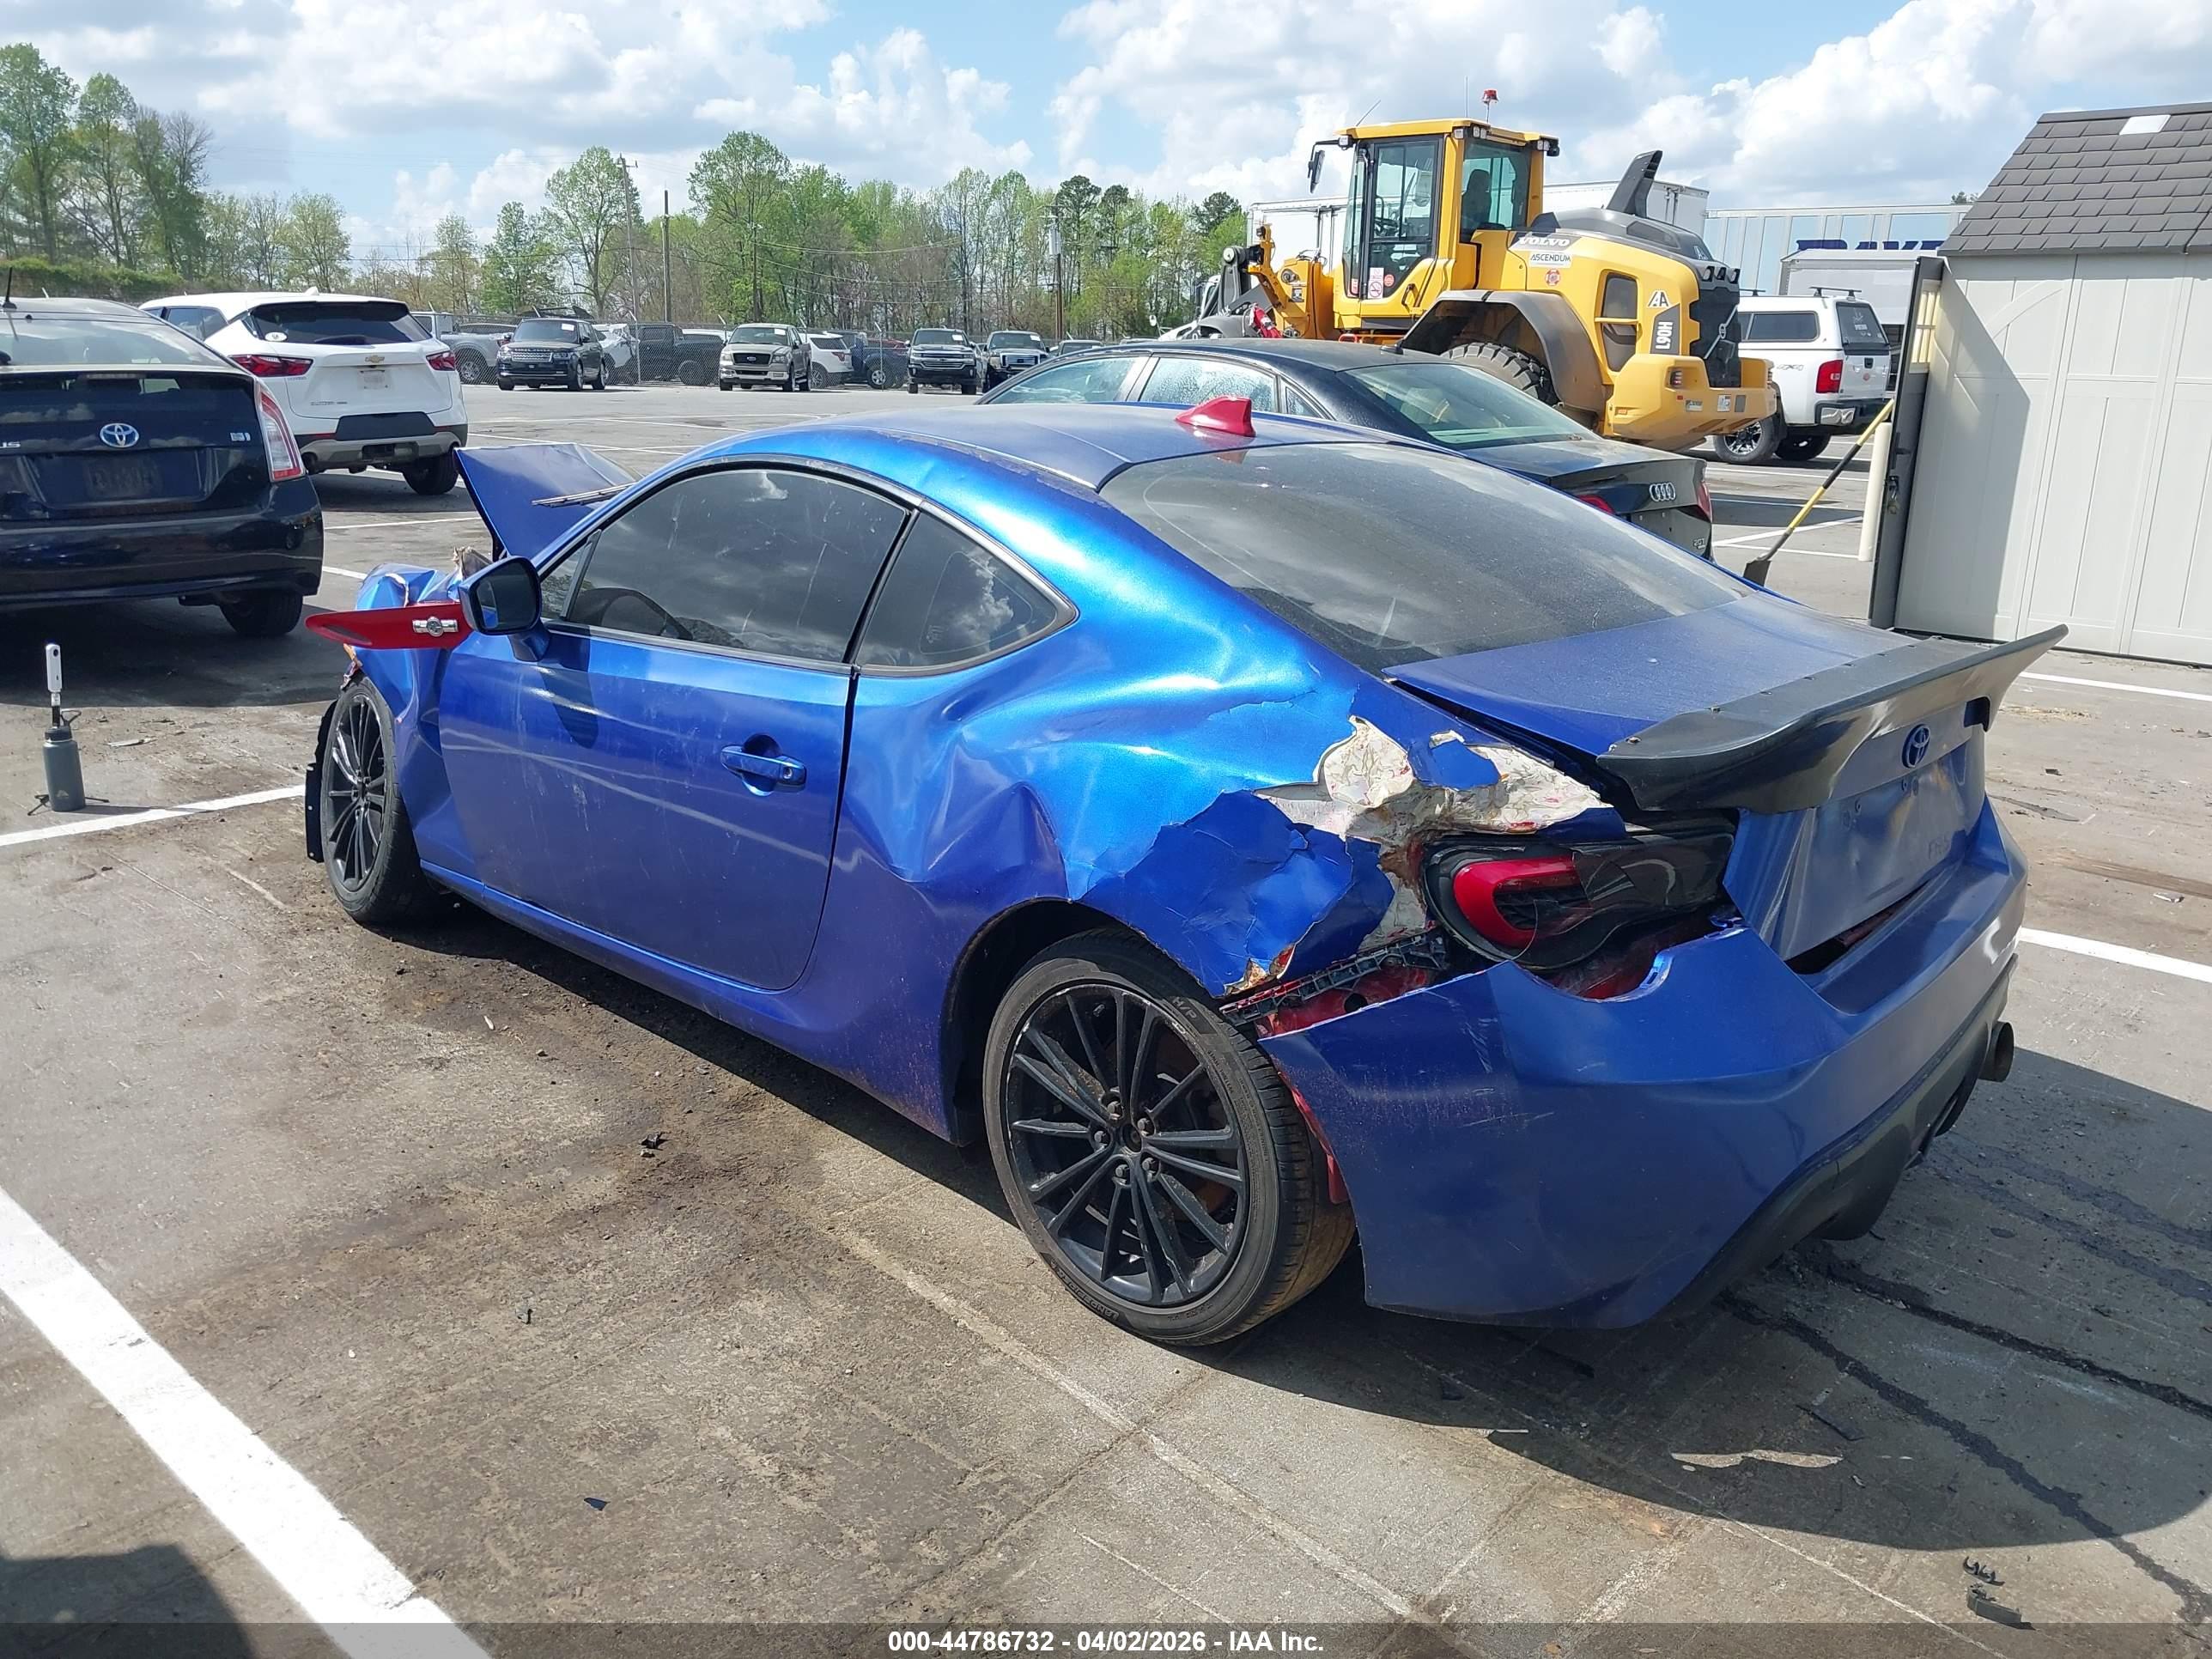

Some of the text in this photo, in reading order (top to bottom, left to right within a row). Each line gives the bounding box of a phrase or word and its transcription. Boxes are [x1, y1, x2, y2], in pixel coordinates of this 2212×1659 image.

[1519, 236, 1571, 247] VOLVO
[1530, 253, 1571, 262] ASCENDUM
[1655, 321, 1674, 349] L90H
[1172, 996, 1197, 1018] H/P
